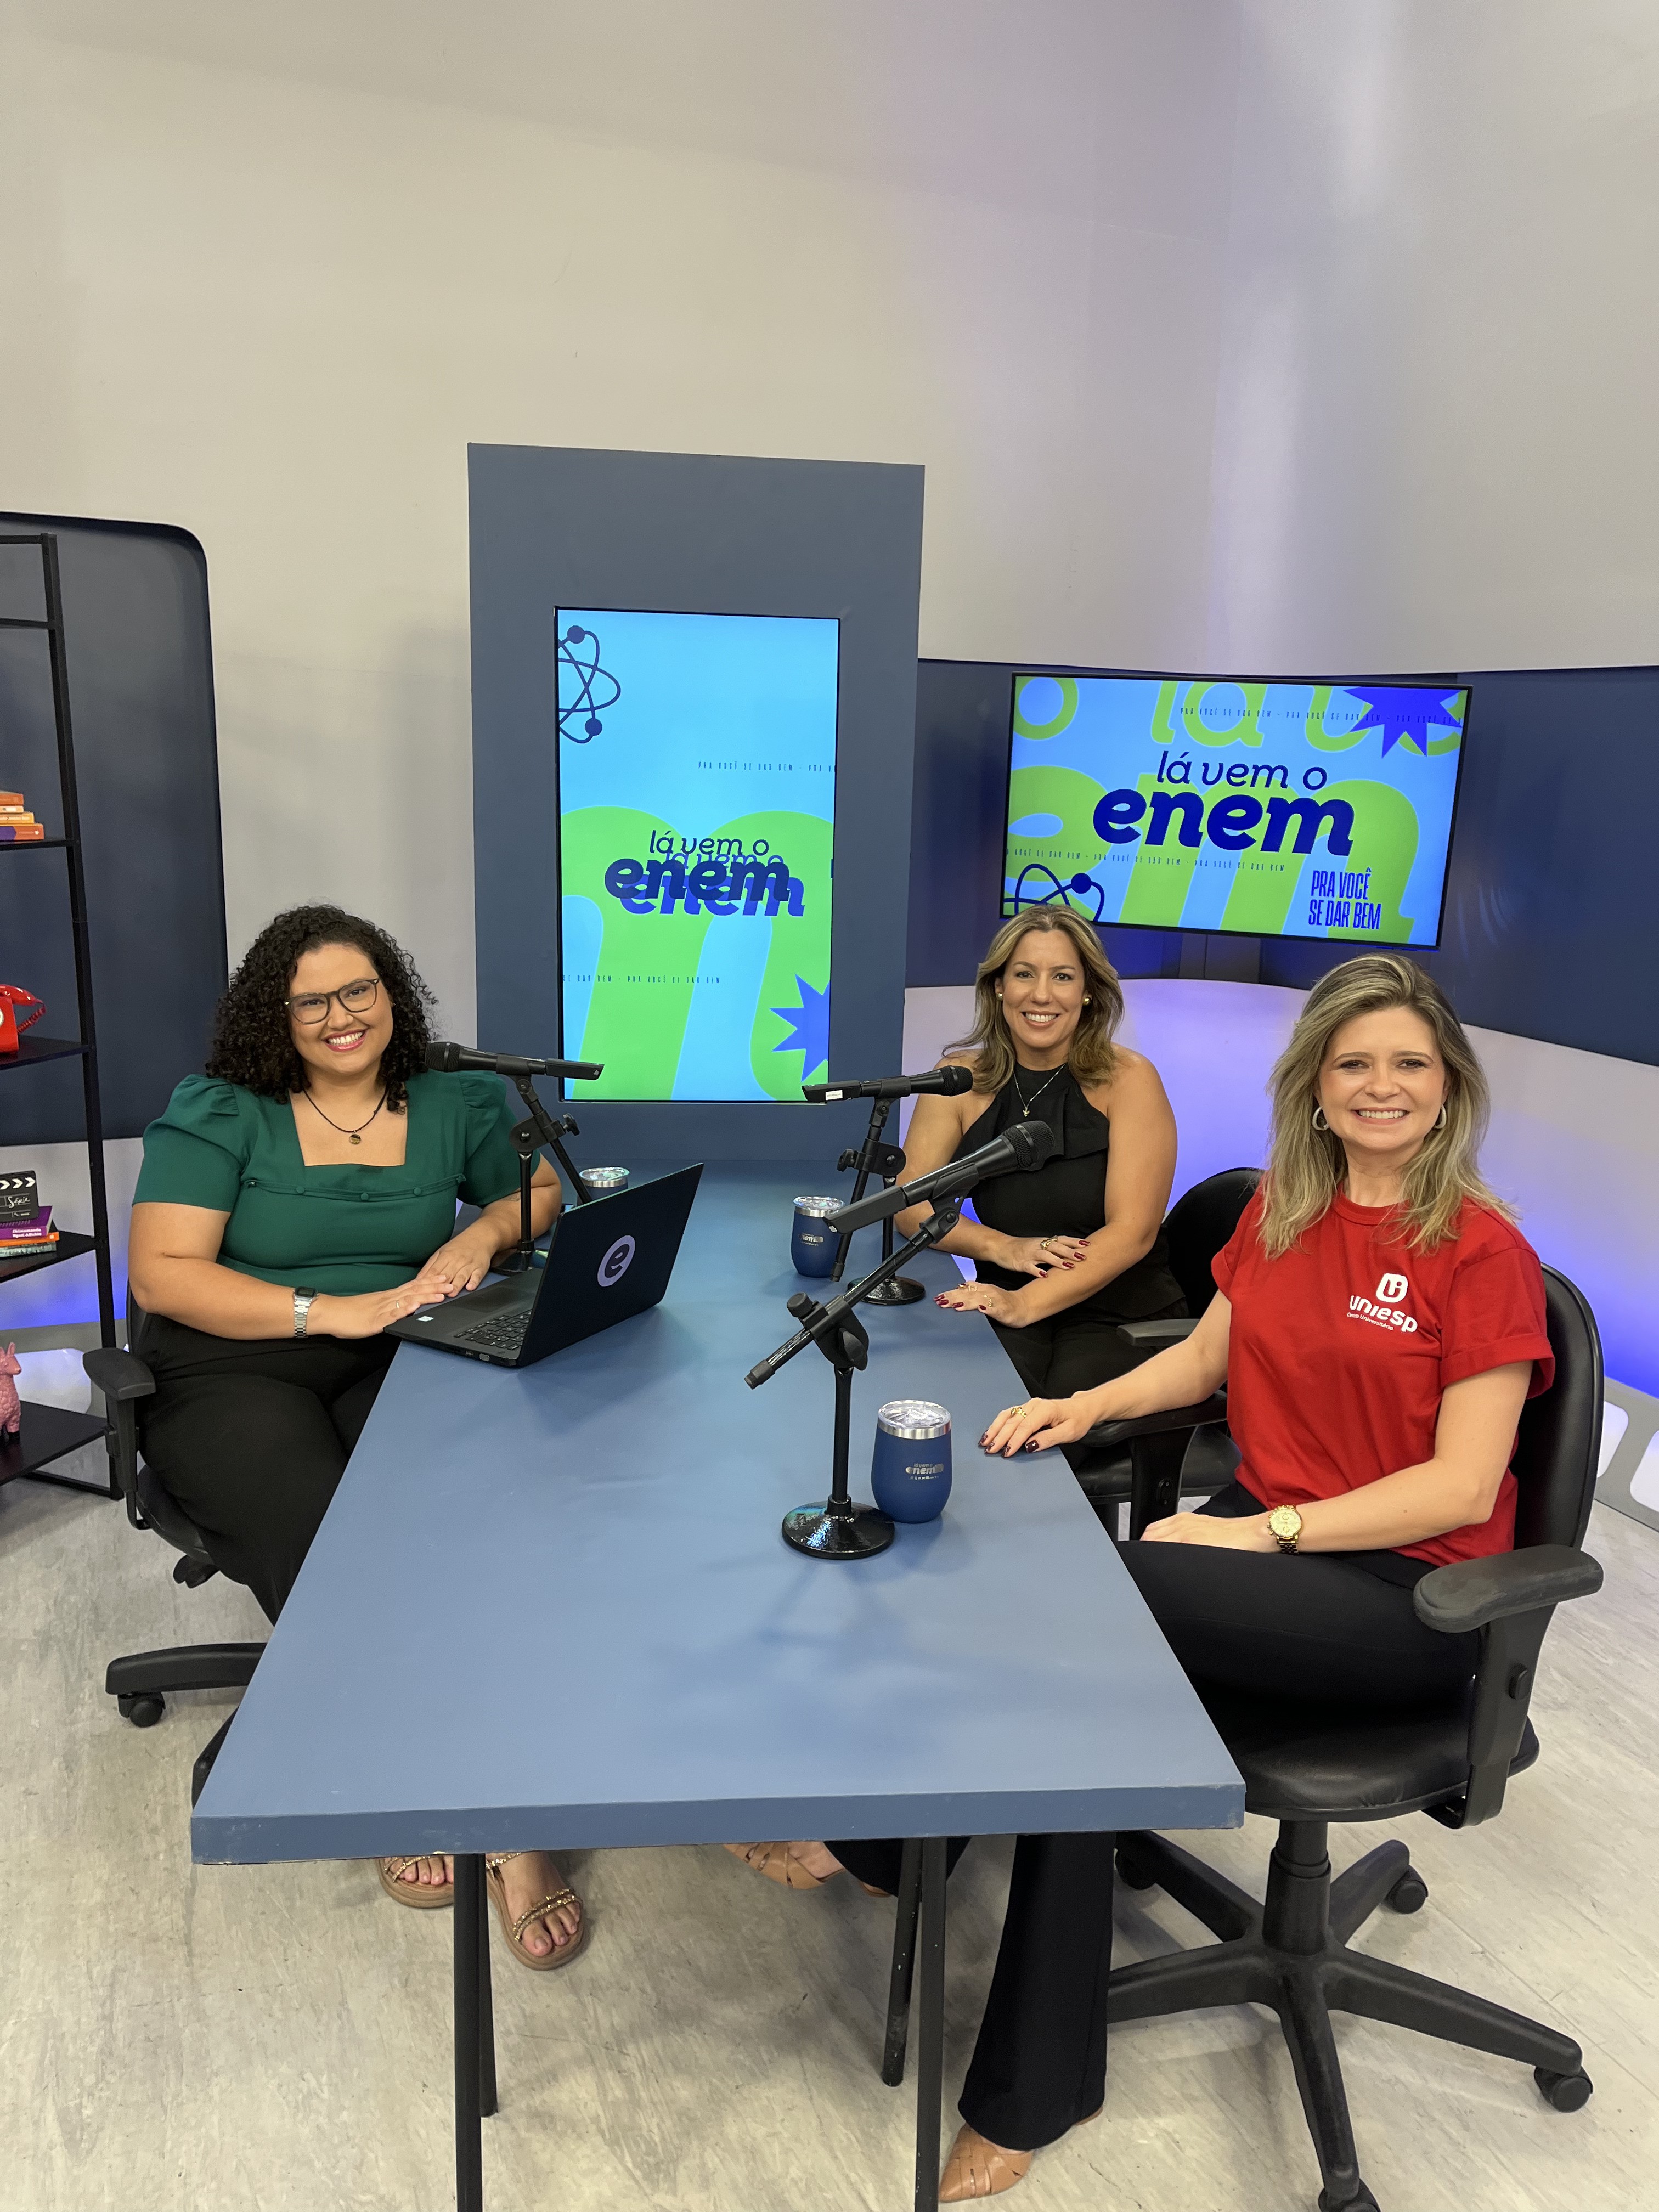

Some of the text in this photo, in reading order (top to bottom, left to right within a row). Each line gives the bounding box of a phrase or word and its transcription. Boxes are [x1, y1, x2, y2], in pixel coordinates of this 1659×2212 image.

[1156, 751, 1328, 791] lá vem o
[1093, 788, 1355, 856] enem
[650, 830, 769, 856] lá vem o
[604, 858, 791, 901] enem
[1311, 867, 1372, 900] PRA VOCÊ
[1308, 899, 1382, 930] SE DAR BEM
[1350, 1295, 1418, 1333] uniesp
